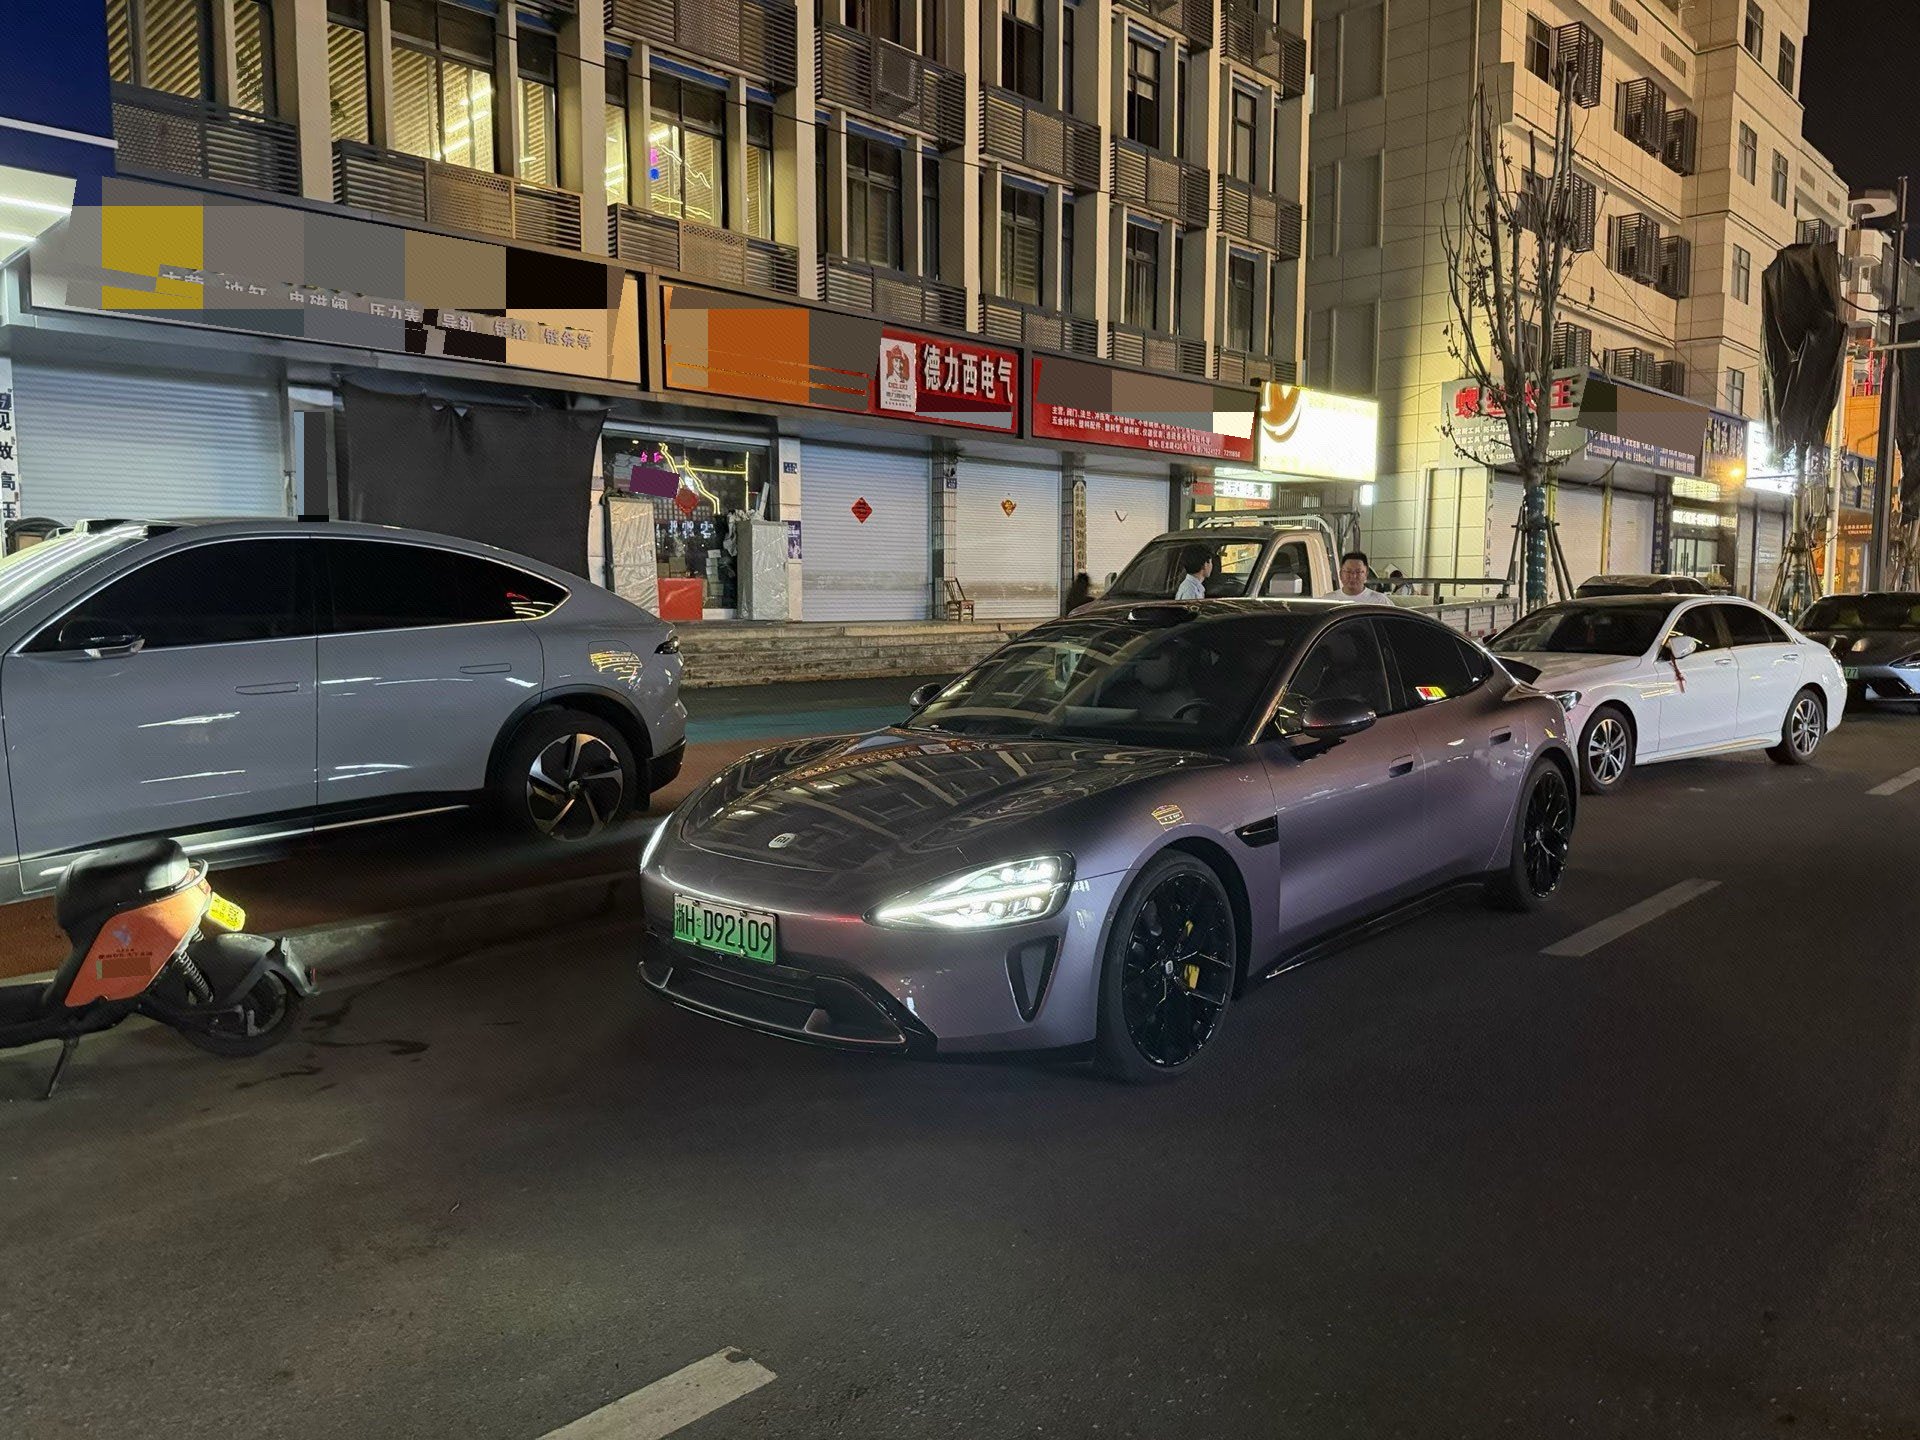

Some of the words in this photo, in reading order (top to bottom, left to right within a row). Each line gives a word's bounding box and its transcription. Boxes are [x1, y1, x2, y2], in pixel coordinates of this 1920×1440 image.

[369, 302, 422, 322] 压力表
[924, 343, 1014, 403] 德力西电气
